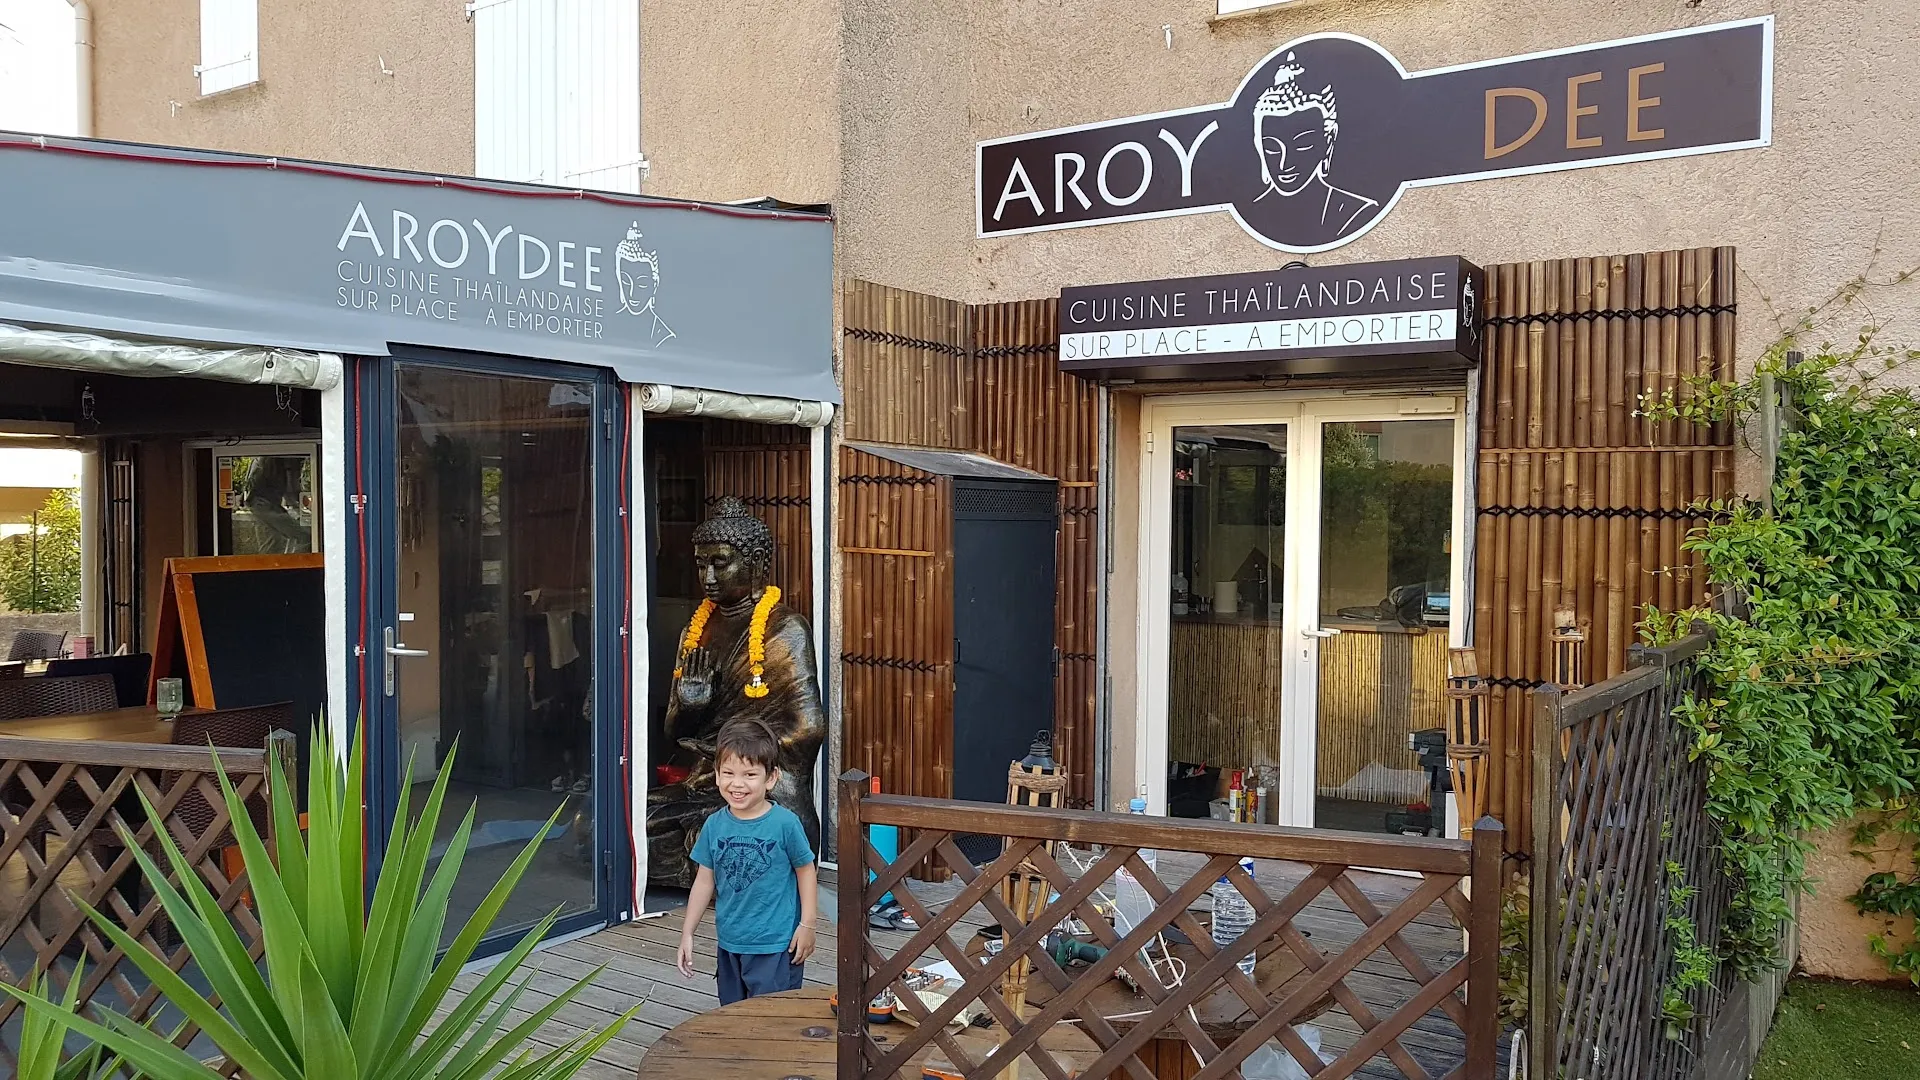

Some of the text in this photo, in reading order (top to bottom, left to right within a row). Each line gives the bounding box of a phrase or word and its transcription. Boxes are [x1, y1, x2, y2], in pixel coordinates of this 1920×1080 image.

[992, 62, 1665, 222] AROY DEE
[336, 201, 603, 293] AROYDEE
[336, 286, 603, 339] SUR PLACE A EMPORTER
[337, 260, 604, 318] CUISINE THAÏLANDAISE
[1069, 272, 1446, 324] CUISINE THAÏLANDAISE
[1066, 335, 1111, 359] SUR
[1125, 329, 1208, 356] PLACE
[1247, 325, 1264, 349] A
[1280, 314, 1442, 347] EMPORTER
